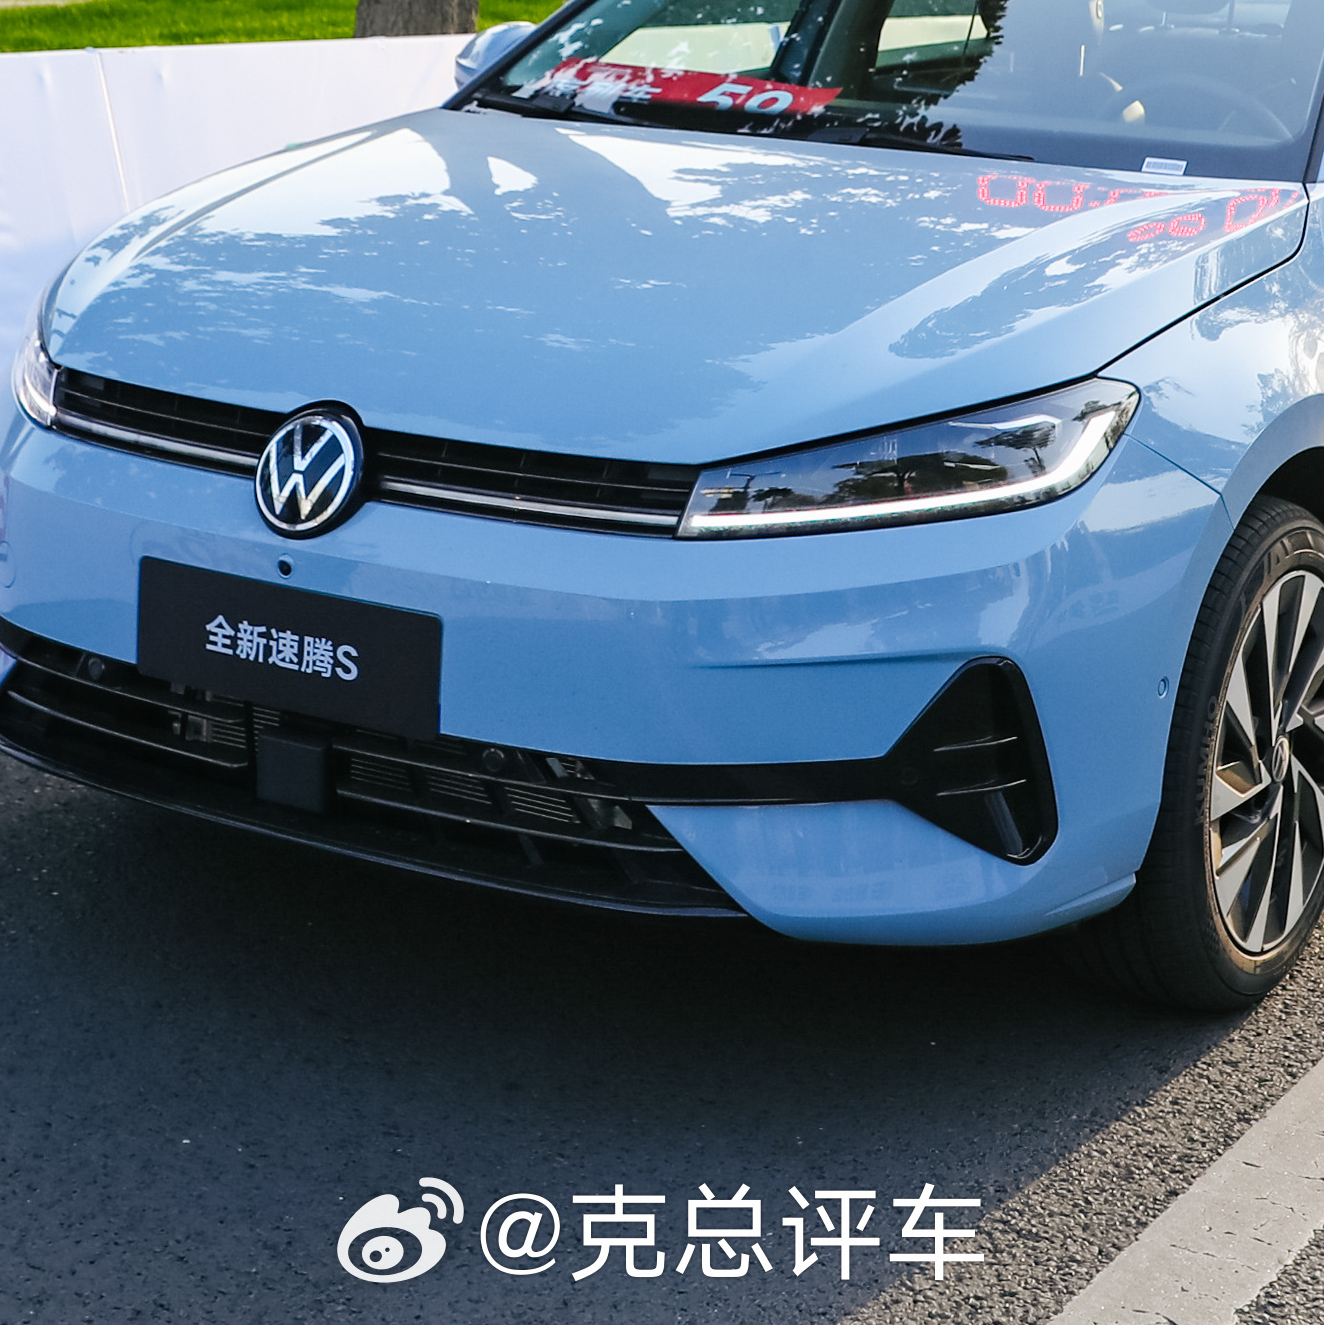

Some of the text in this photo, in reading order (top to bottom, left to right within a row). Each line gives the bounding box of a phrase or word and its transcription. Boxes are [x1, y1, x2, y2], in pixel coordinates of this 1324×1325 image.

[205, 614, 360, 682] 全新速腾S
[1193, 694, 1219, 826] KUMHO
